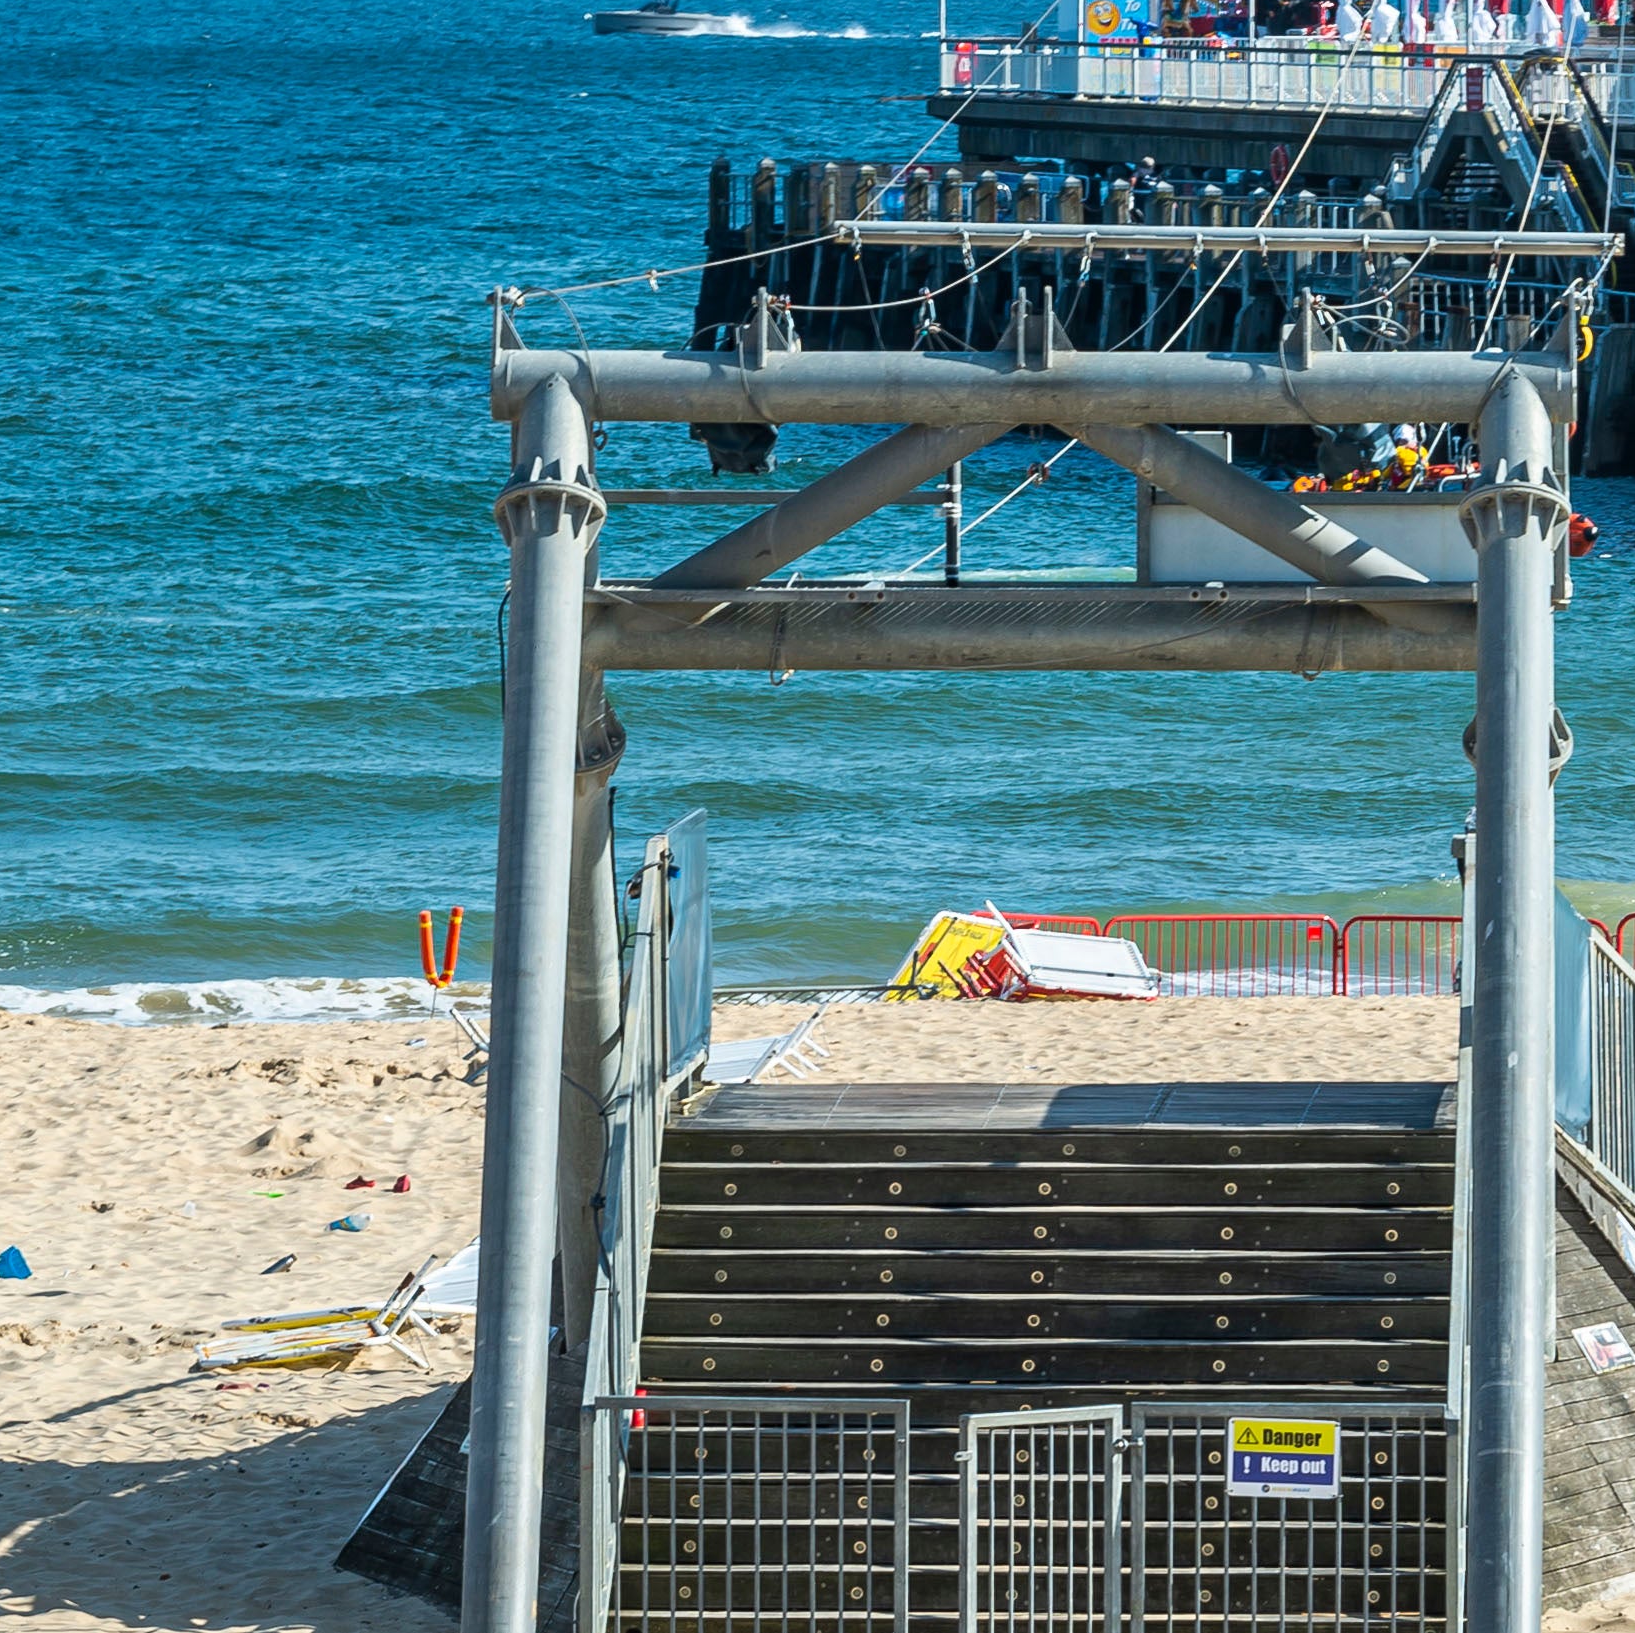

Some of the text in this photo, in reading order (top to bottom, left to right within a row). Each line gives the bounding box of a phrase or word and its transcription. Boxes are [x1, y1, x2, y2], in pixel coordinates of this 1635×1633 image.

[1125, 0, 1140, 12] To
[1121, 18, 1136, 30] Th
[1263, 1429, 1322, 1448] Danger
[1261, 1457, 1326, 1474] Keep out
